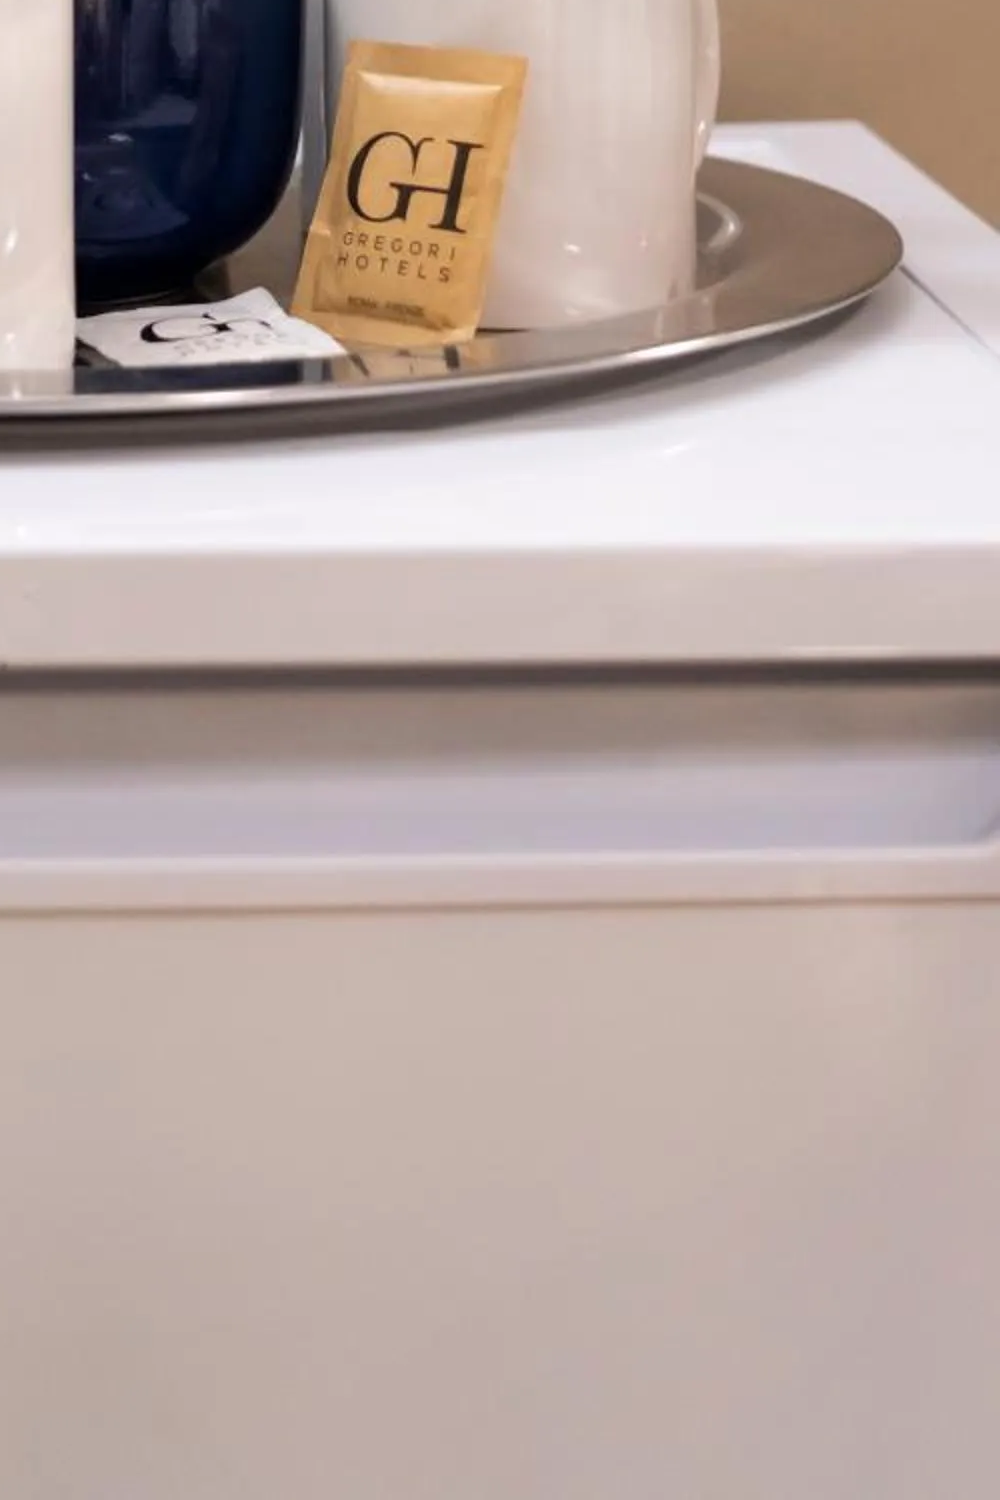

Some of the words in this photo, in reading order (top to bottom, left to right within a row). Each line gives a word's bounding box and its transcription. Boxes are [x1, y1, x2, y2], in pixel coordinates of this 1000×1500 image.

[346, 130, 486, 235] GH
[342, 230, 458, 262] GREGORI
[336, 251, 451, 284] HOTELS
